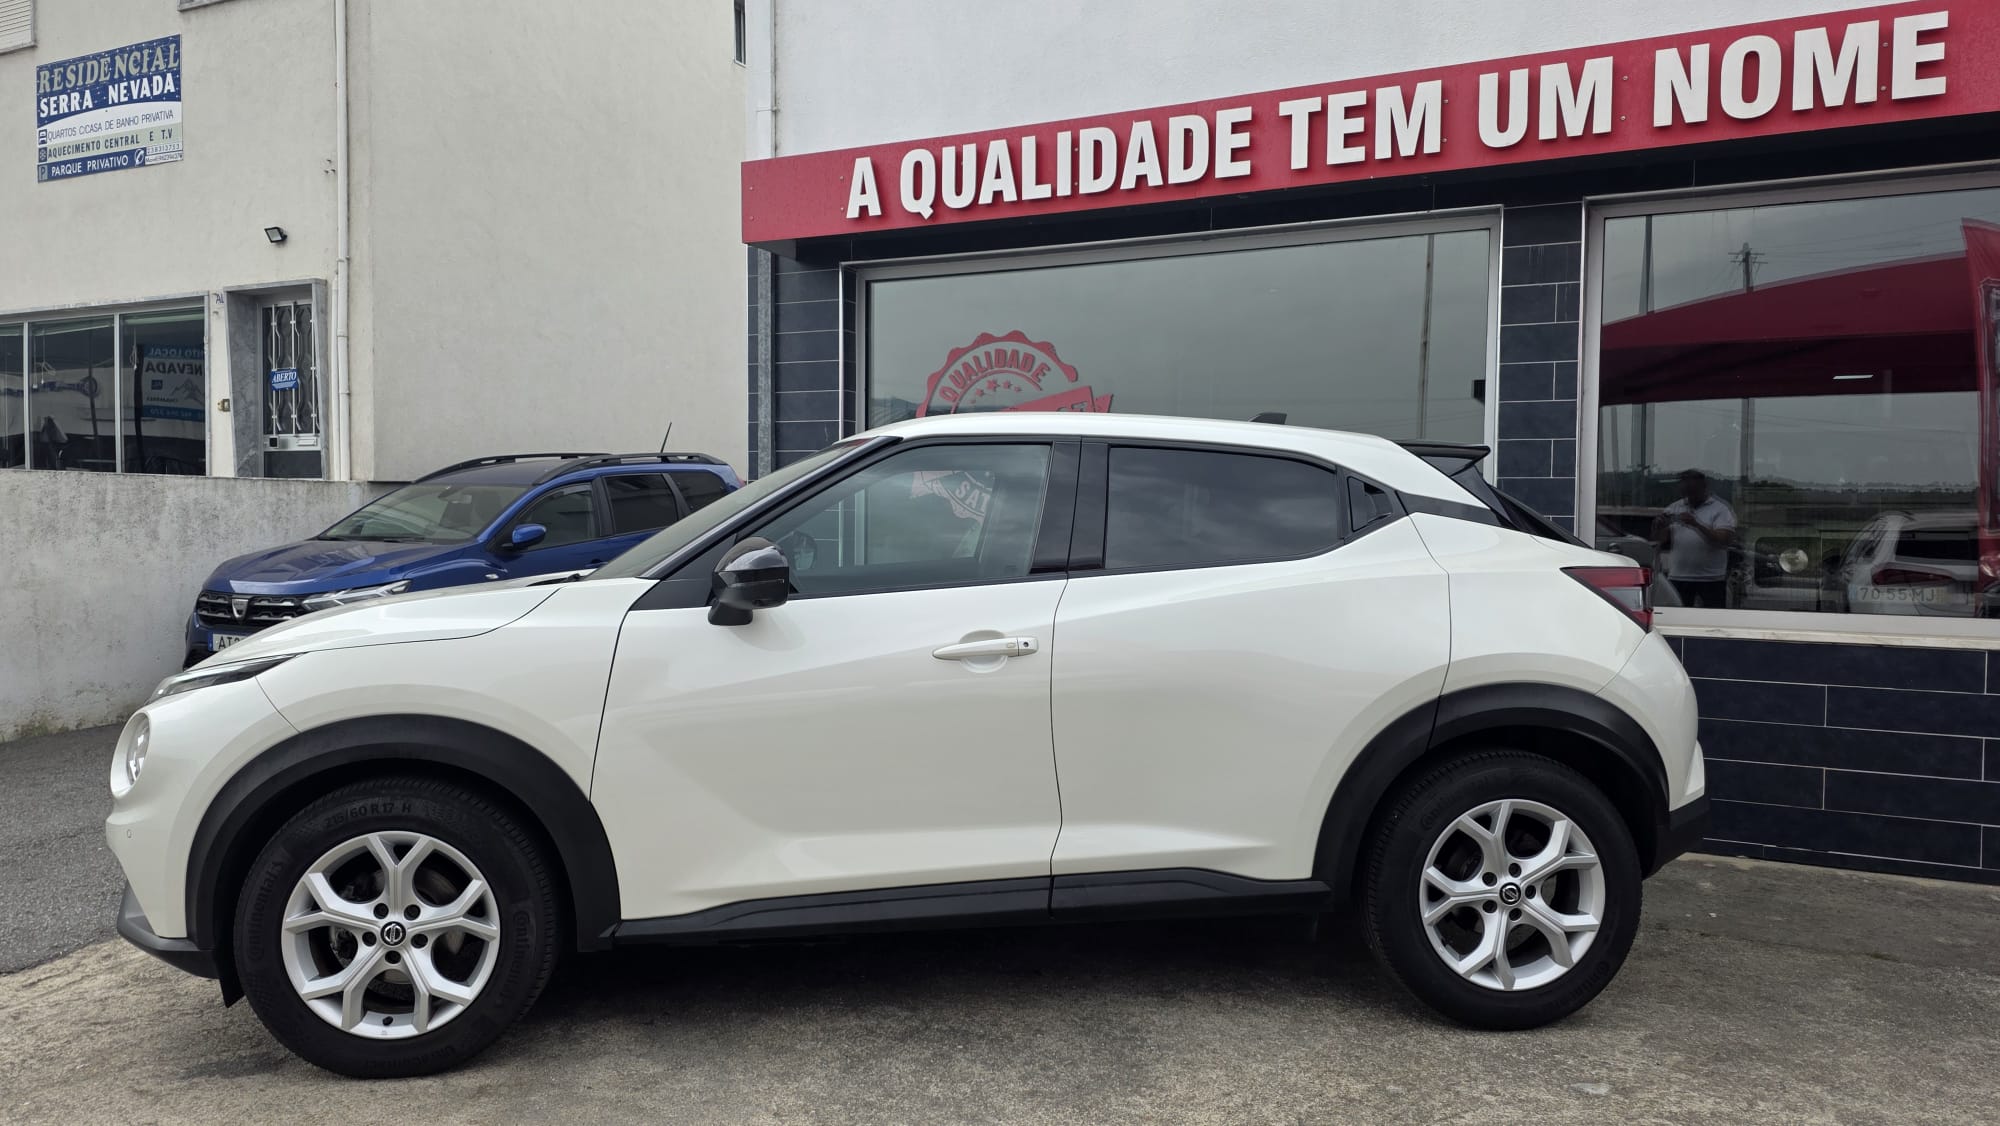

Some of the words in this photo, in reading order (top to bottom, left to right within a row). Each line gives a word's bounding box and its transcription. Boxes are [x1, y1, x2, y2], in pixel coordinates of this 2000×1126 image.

[38, 43, 180, 94] RESIDENCIAL
[39, 90, 93, 118] SERRA
[108, 72, 176, 105] NEVADA
[48, 128, 77, 141] QUARTOS
[104, 120, 114, 130] DE
[116, 115, 140, 127] BANHO
[141, 109, 174, 124] PRIVATIVA
[845, 157, 882, 219] A
[900, 106, 1252, 220] QUALIDADE
[1279, 80, 1442, 170] TEM
[1478, 56, 1614, 149] UM
[1653, 10, 1949, 127] NOME
[47, 141, 102, 159] AQUECIMENTO
[104, 133, 140, 151] CENTRAL
[149, 130, 155, 142] E
[51, 163, 82, 177] PARQUE
[87, 154, 129, 171] PRIVATIVO
[272, 371, 297, 383] ABERTO
[939, 348, 1051, 403] QUALIDADE
[325, 806, 367, 827] 215/60
[402, 803, 412, 814] H
